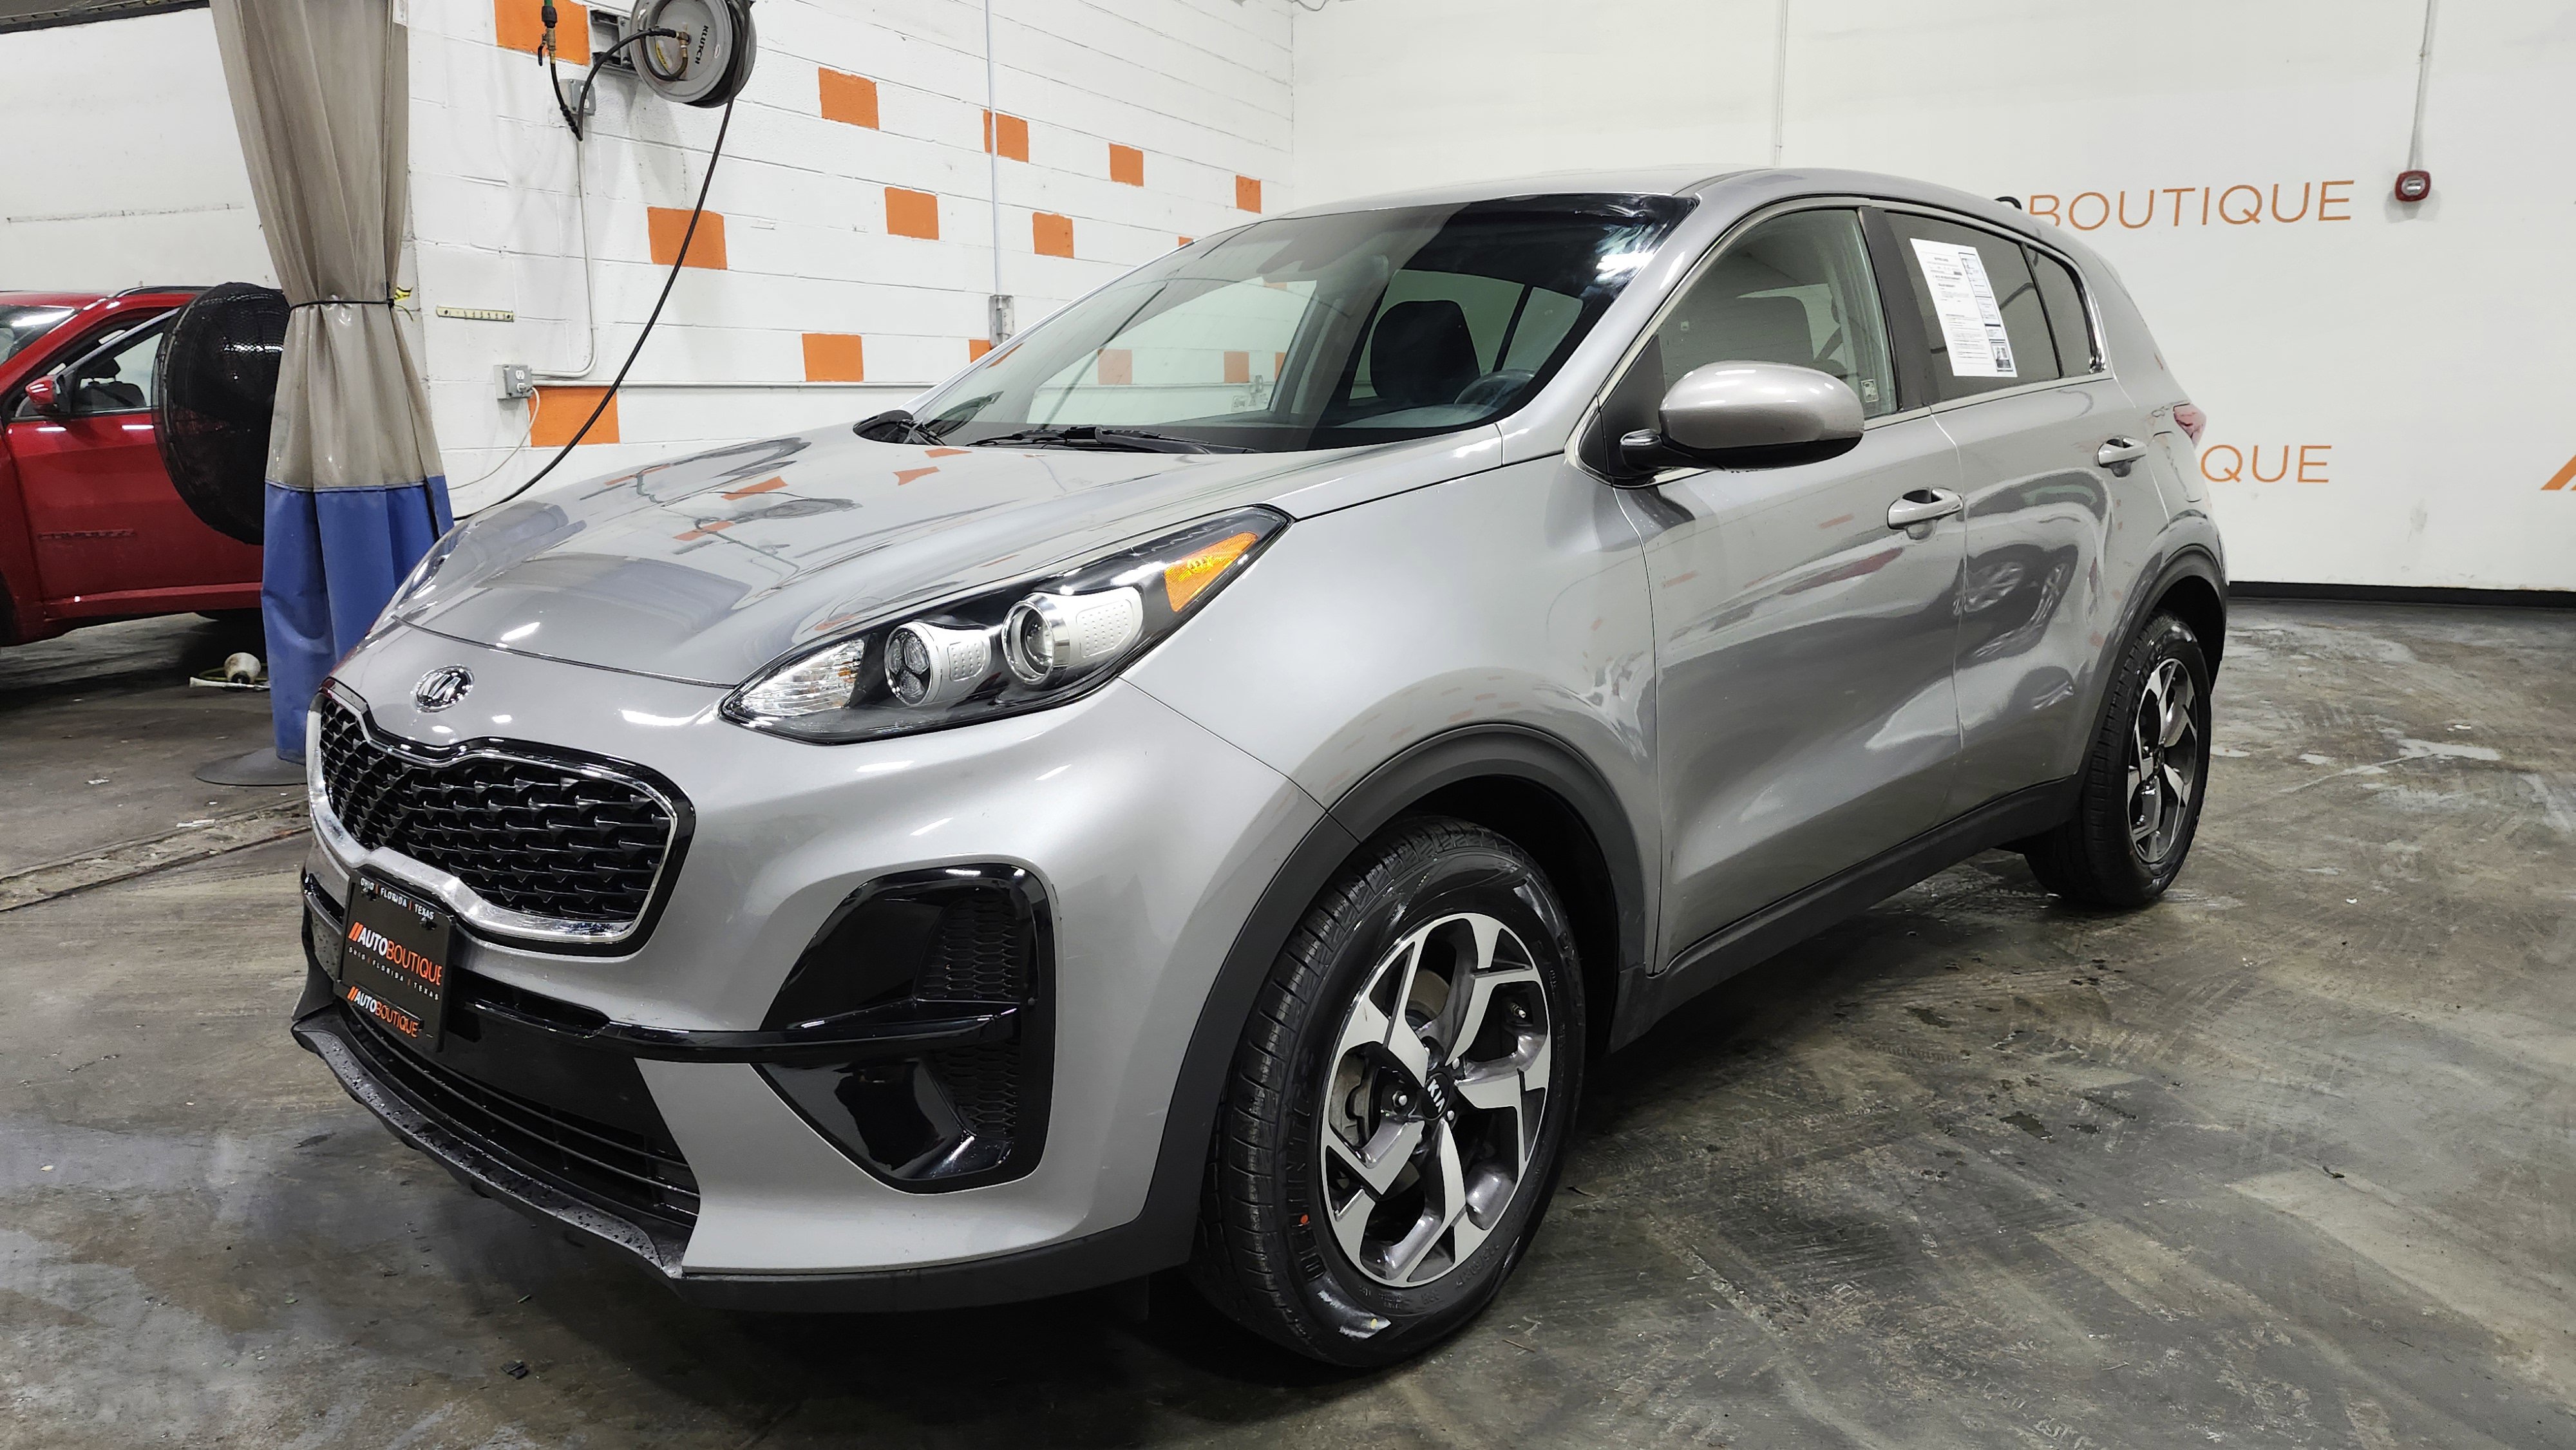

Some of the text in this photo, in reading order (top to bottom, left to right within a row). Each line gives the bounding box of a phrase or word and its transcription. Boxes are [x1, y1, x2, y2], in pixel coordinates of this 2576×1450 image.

[694, 24, 709, 64] KLUTCH
[1994, 180, 2354, 231] BOUTIQUE
[418, 672, 462, 702] KIA
[360, 876, 435, 921] OHIO FLORIDA TEXAS
[348, 946, 439, 1001] OHIO FLORIDA TEXAS
[357, 927, 443, 986] AUTOBOUTIQUE
[354, 990, 419, 1038] AUTOBOUTIQUE
[1426, 1078, 1446, 1114] KIA
